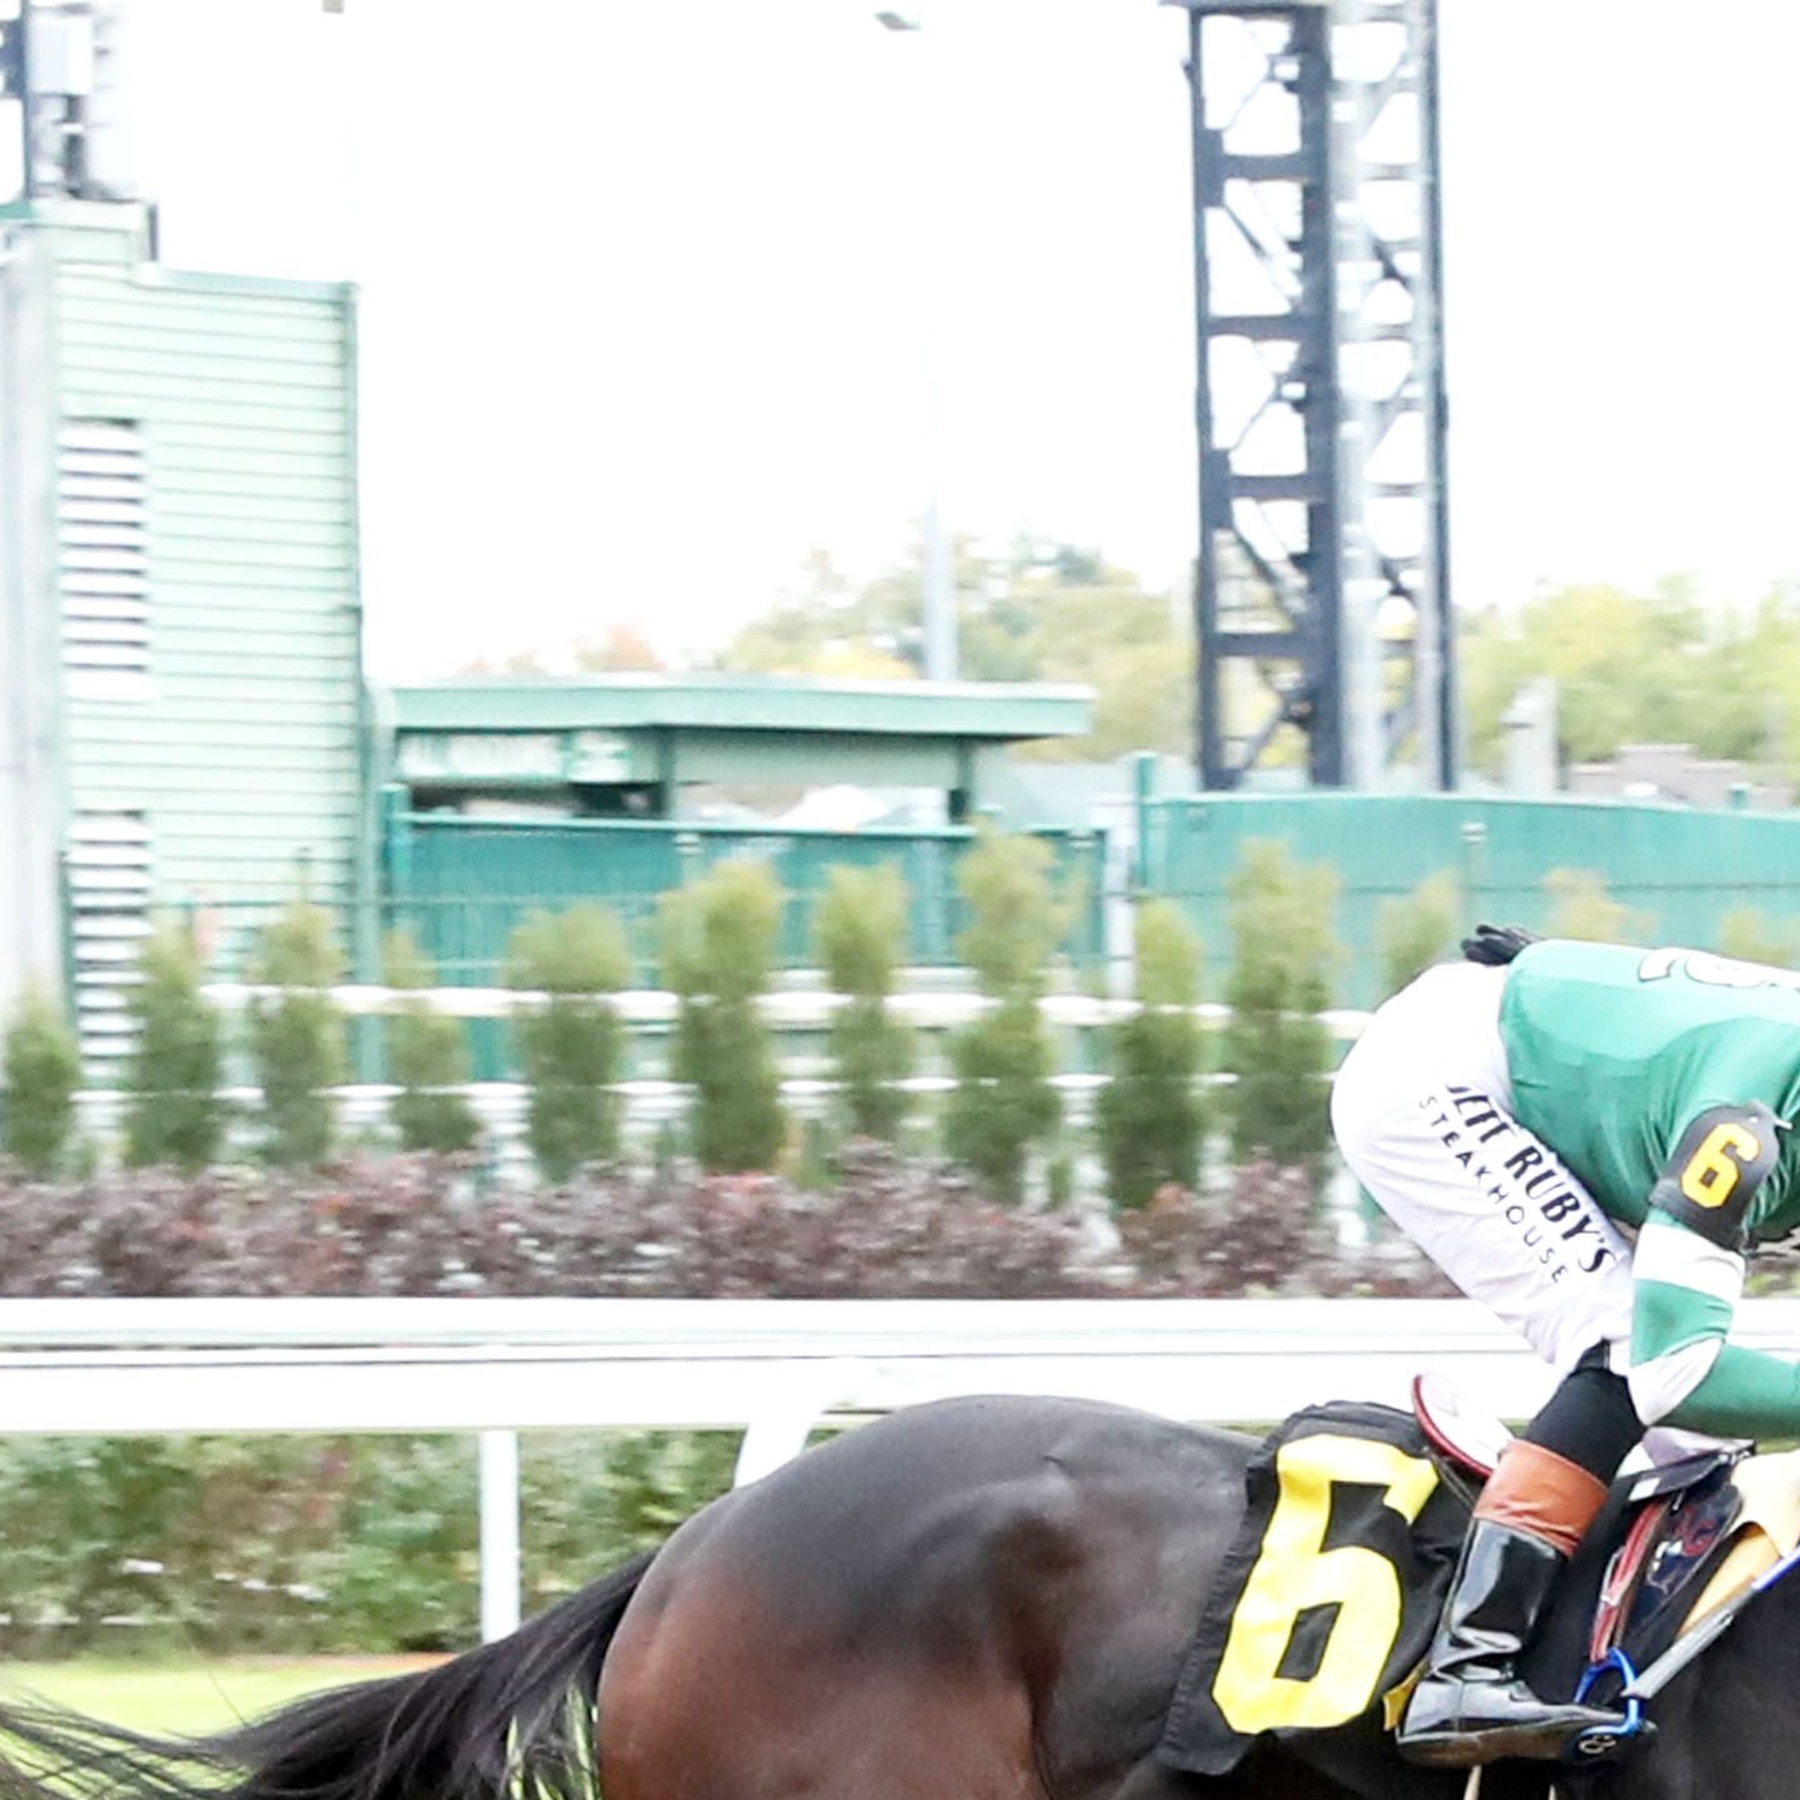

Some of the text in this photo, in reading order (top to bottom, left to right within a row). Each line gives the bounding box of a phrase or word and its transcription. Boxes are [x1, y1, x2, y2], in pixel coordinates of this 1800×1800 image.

[1419, 1095, 1568, 1283] STEAKHOUSE
[1502, 1145, 1617, 1273] RUBY'S
[1680, 1122, 1761, 1209] 6
[1211, 1433, 1440, 1735] 6
